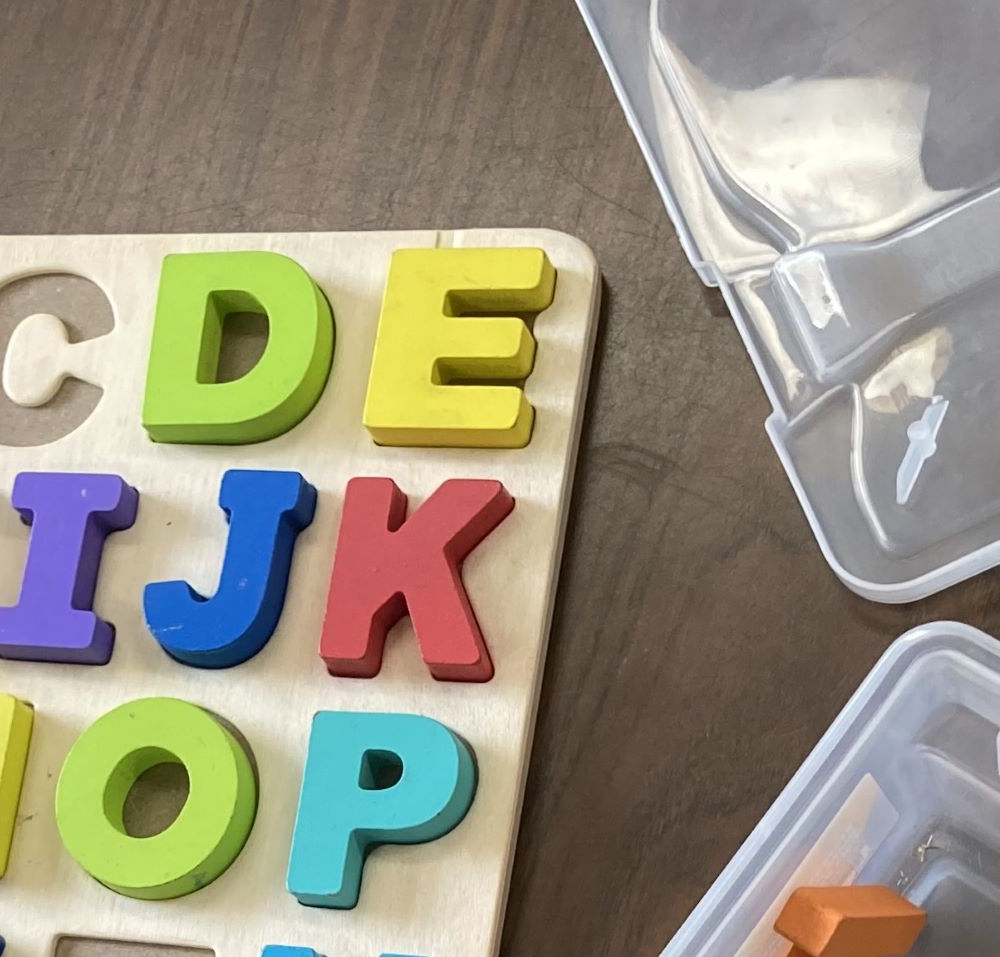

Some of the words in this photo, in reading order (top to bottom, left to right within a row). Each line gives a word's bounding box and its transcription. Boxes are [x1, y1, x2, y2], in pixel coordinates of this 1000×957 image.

[142, 250, 335, 445] D
[363, 247, 557, 448] E
[143, 469, 318, 669] J
[319, 477, 516, 683] K
[55, 697, 258, 900] O
[286, 710, 479, 910] P
